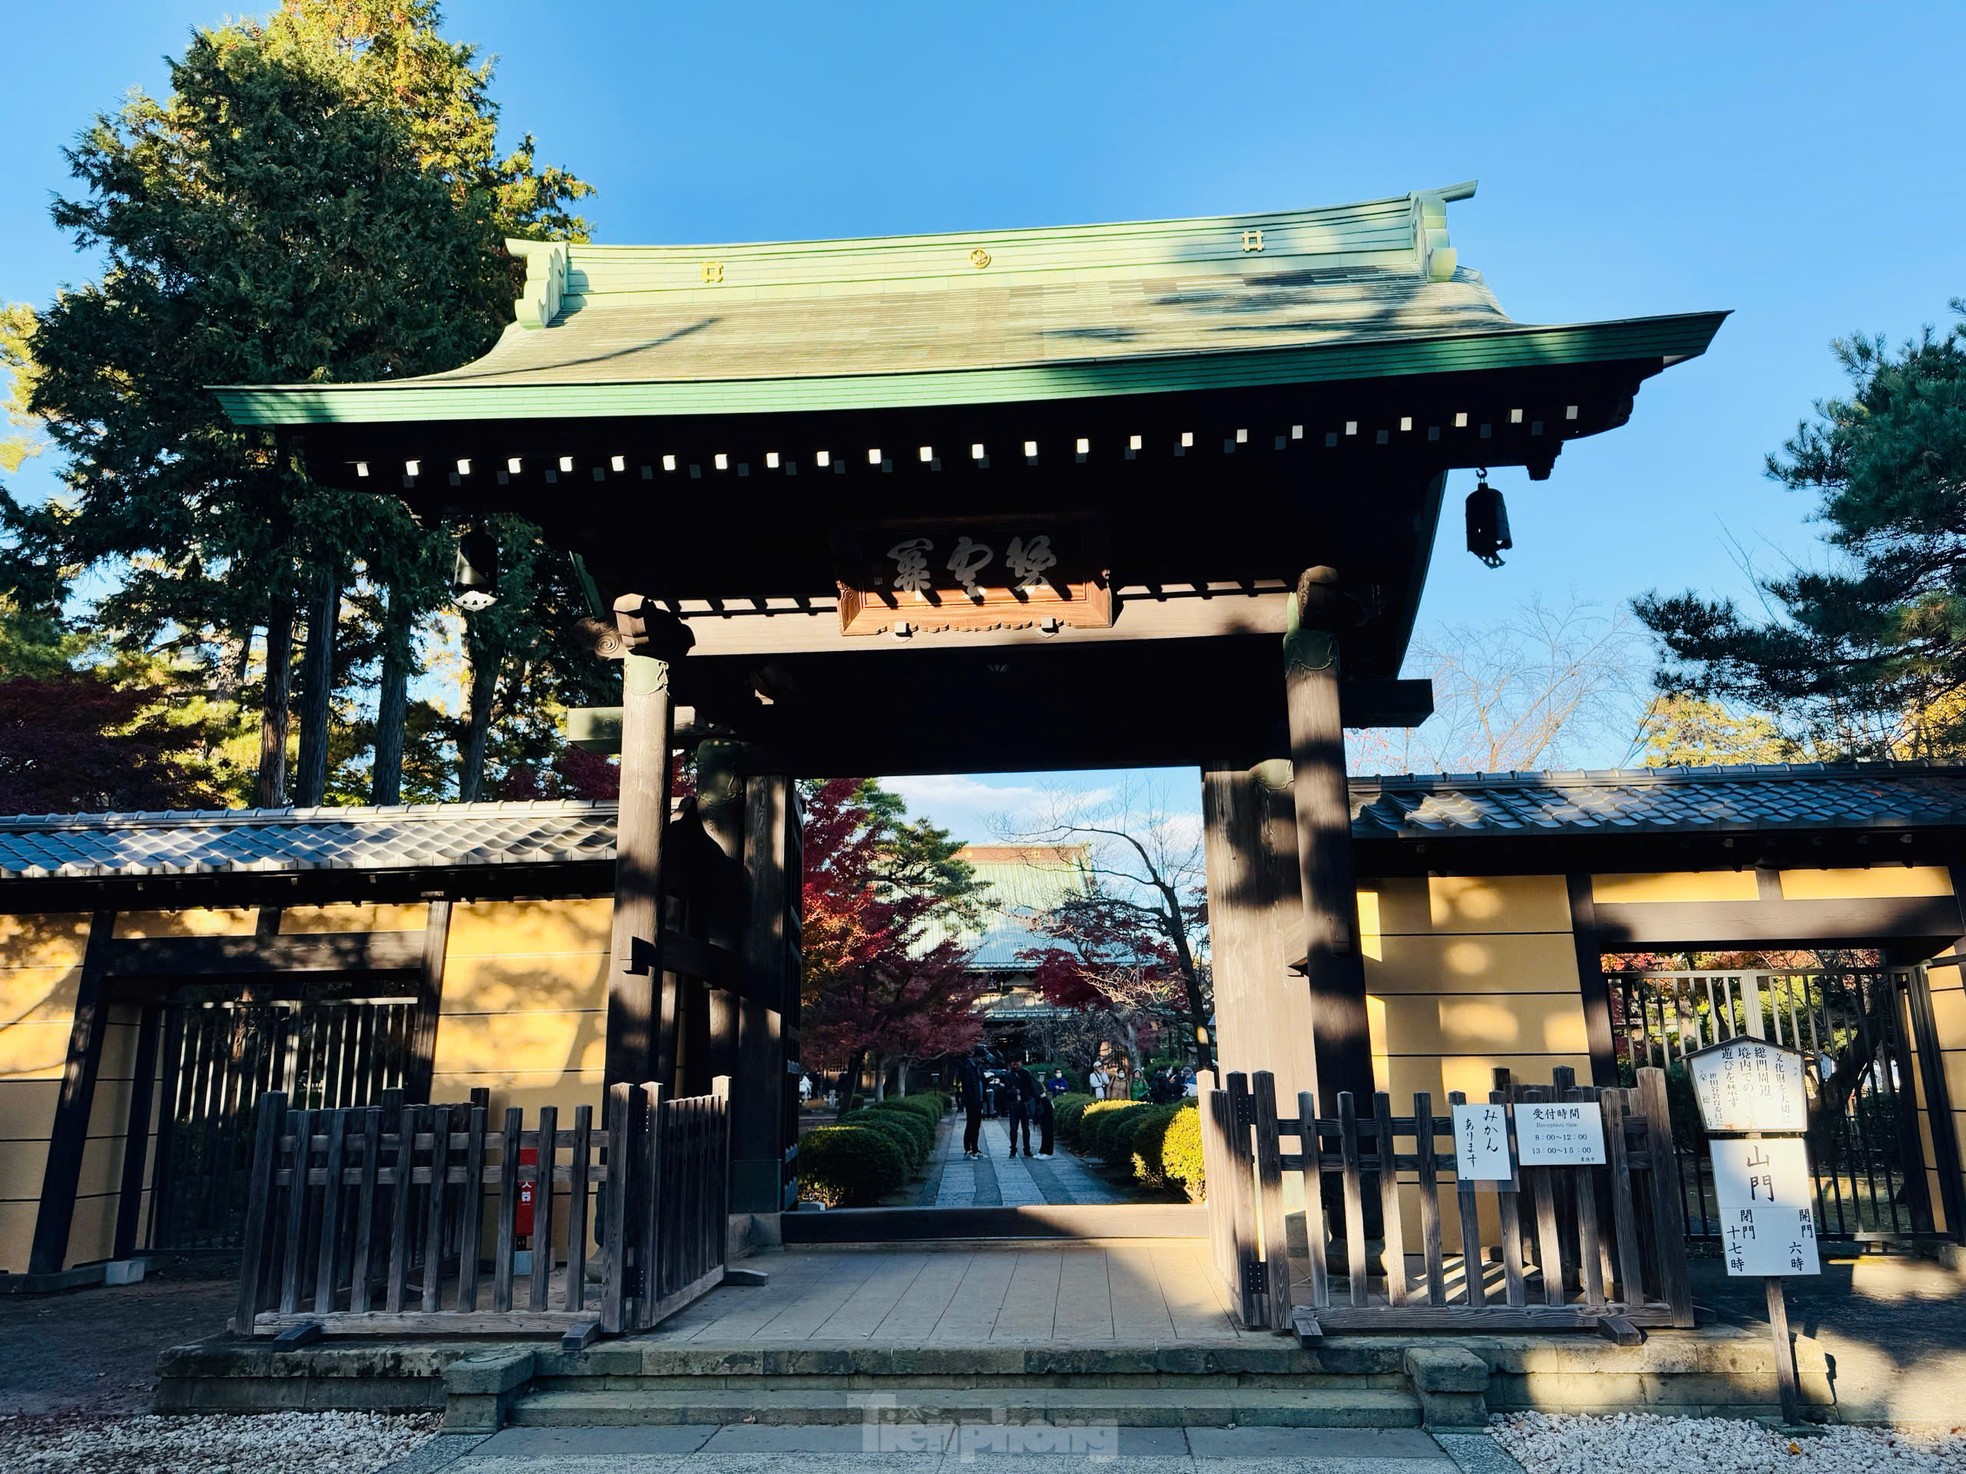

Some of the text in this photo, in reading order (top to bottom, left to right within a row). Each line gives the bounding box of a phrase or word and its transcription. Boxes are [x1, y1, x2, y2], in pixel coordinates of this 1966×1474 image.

[1484, 1109, 1499, 1152] みかん
[1533, 1108, 1580, 1120] 受付時間
[1465, 1118, 1477, 1168] あります
[1746, 1145, 1775, 1203] 山門
[1726, 1225, 1745, 1272] 十七時
[1788, 1241, 1804, 1272] 六時
